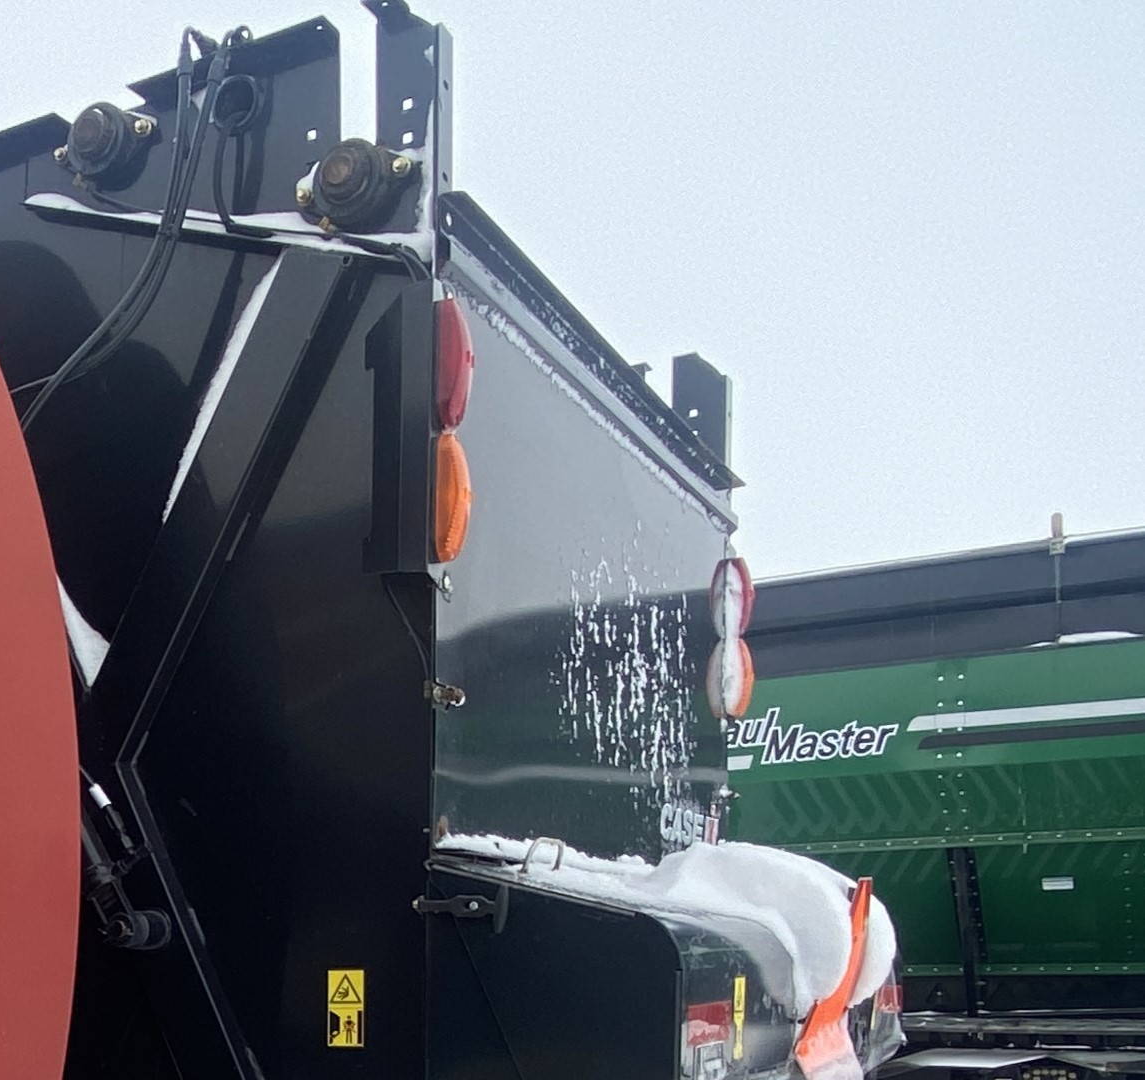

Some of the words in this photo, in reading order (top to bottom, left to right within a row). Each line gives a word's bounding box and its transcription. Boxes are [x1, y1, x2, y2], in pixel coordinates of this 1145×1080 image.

[727, 707, 781, 748] aul
[760, 720, 899, 765] Master
[660, 803, 704, 847] CASE
